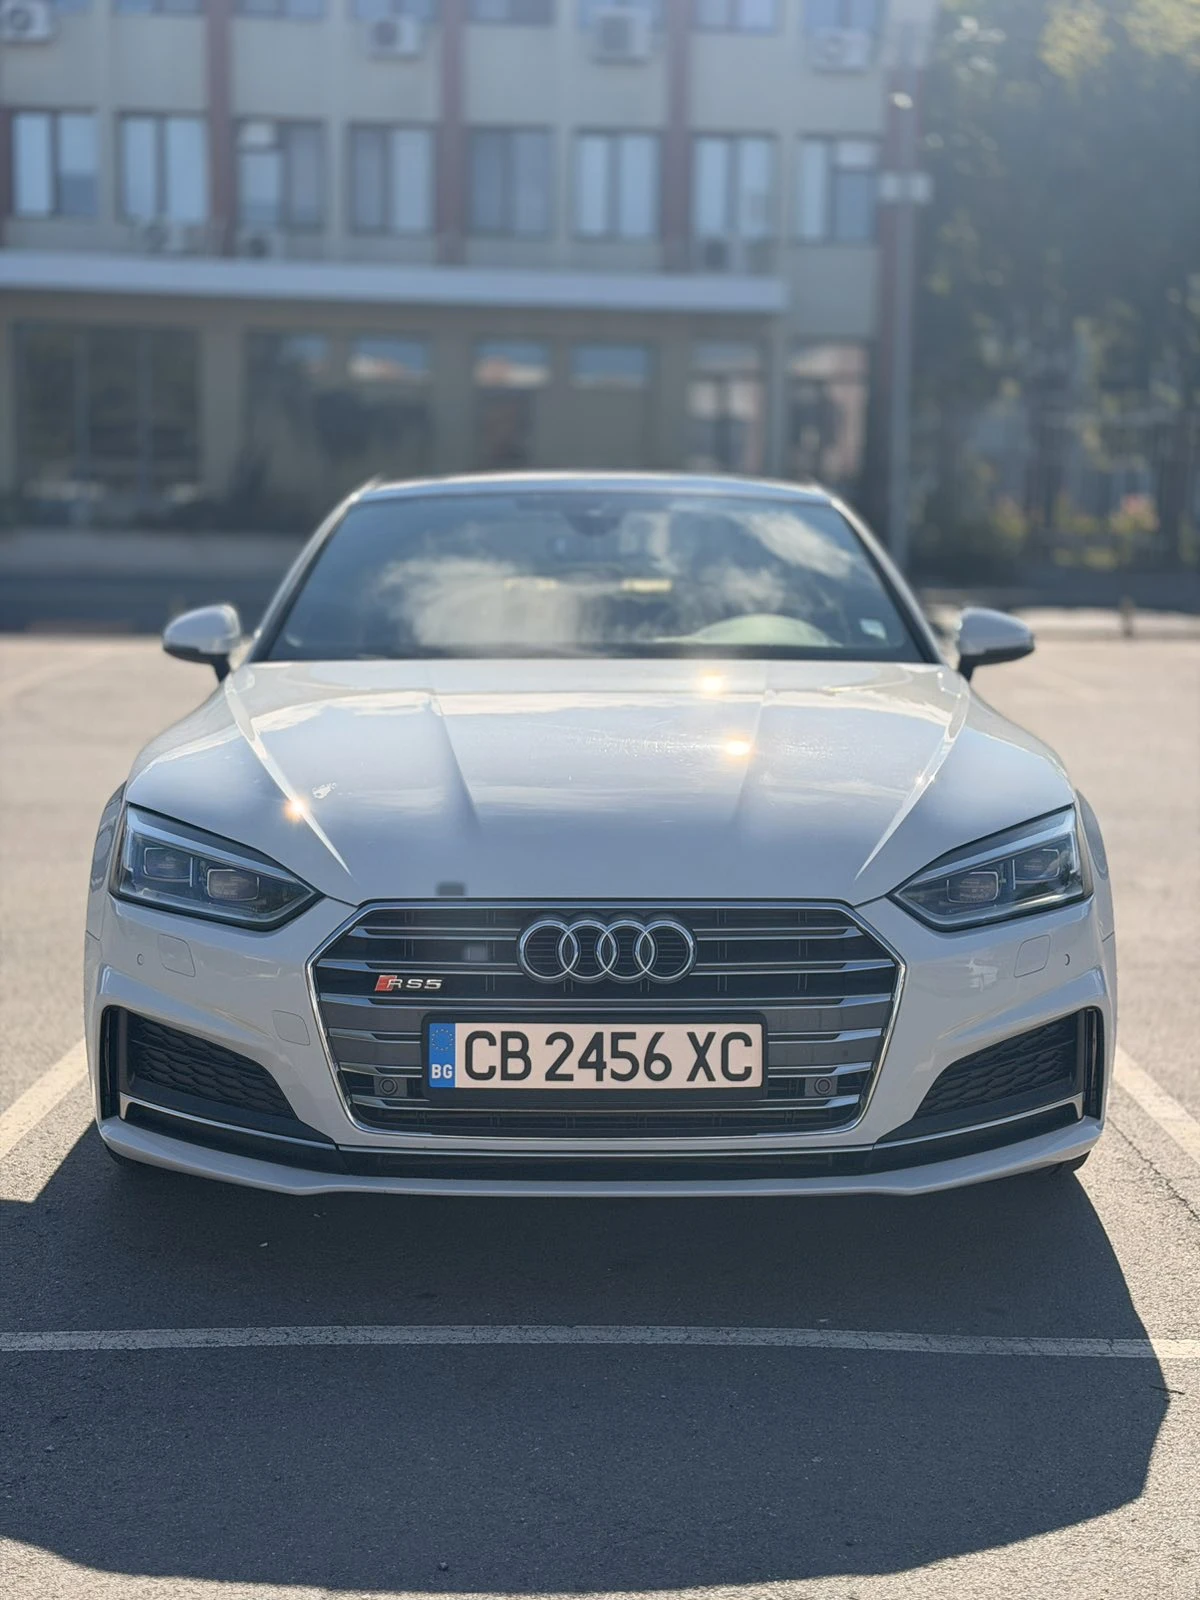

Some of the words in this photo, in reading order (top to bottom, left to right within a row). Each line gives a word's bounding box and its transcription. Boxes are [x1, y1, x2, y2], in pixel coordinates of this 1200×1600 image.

[431, 1064, 453, 1079] BG
[465, 1030, 532, 1082] CB
[544, 1031, 672, 1082] 2456
[686, 1031, 753, 1082] XC
